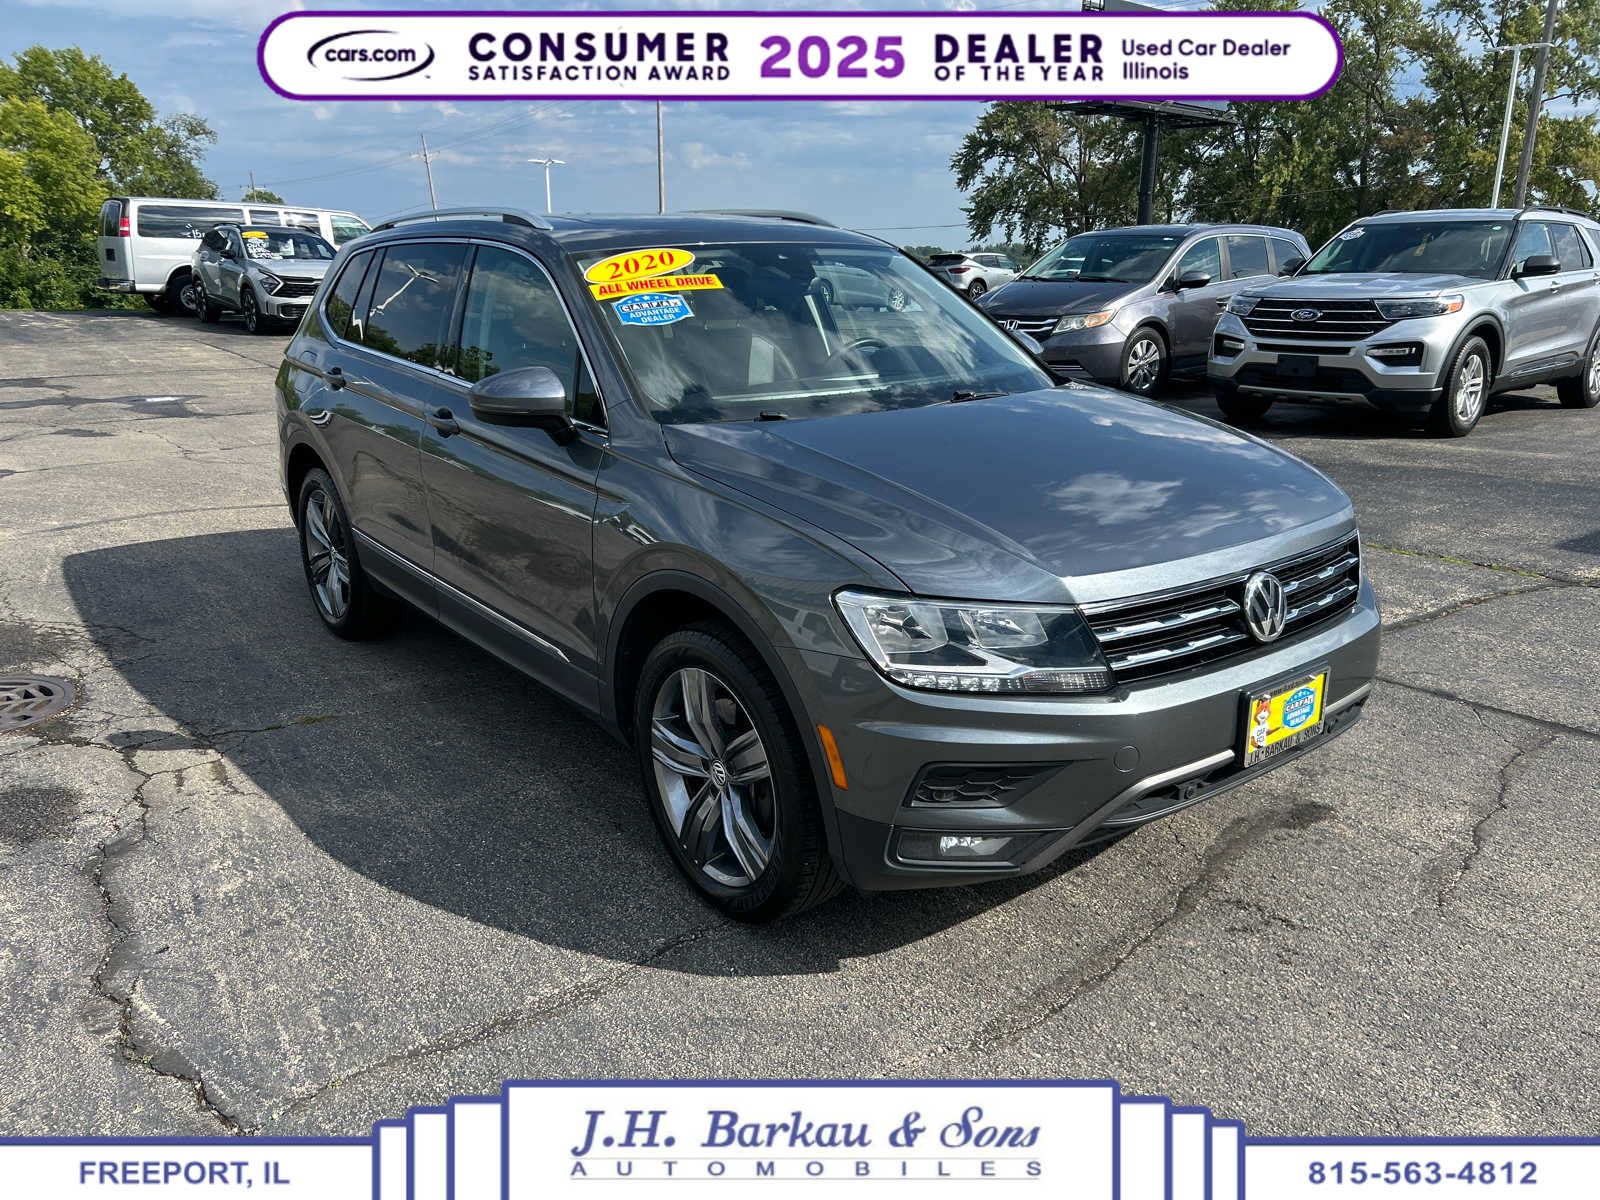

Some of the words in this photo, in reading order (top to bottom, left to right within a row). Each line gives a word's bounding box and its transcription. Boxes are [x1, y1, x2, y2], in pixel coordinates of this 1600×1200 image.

[606, 251, 674, 280] 2020
[599, 284, 624, 296] ALL
[627, 279, 672, 291] WHEEL
[676, 276, 714, 287] DRIVE
[630, 307, 681, 319] ADVANTAGE
[640, 314, 676, 323] DEALER
